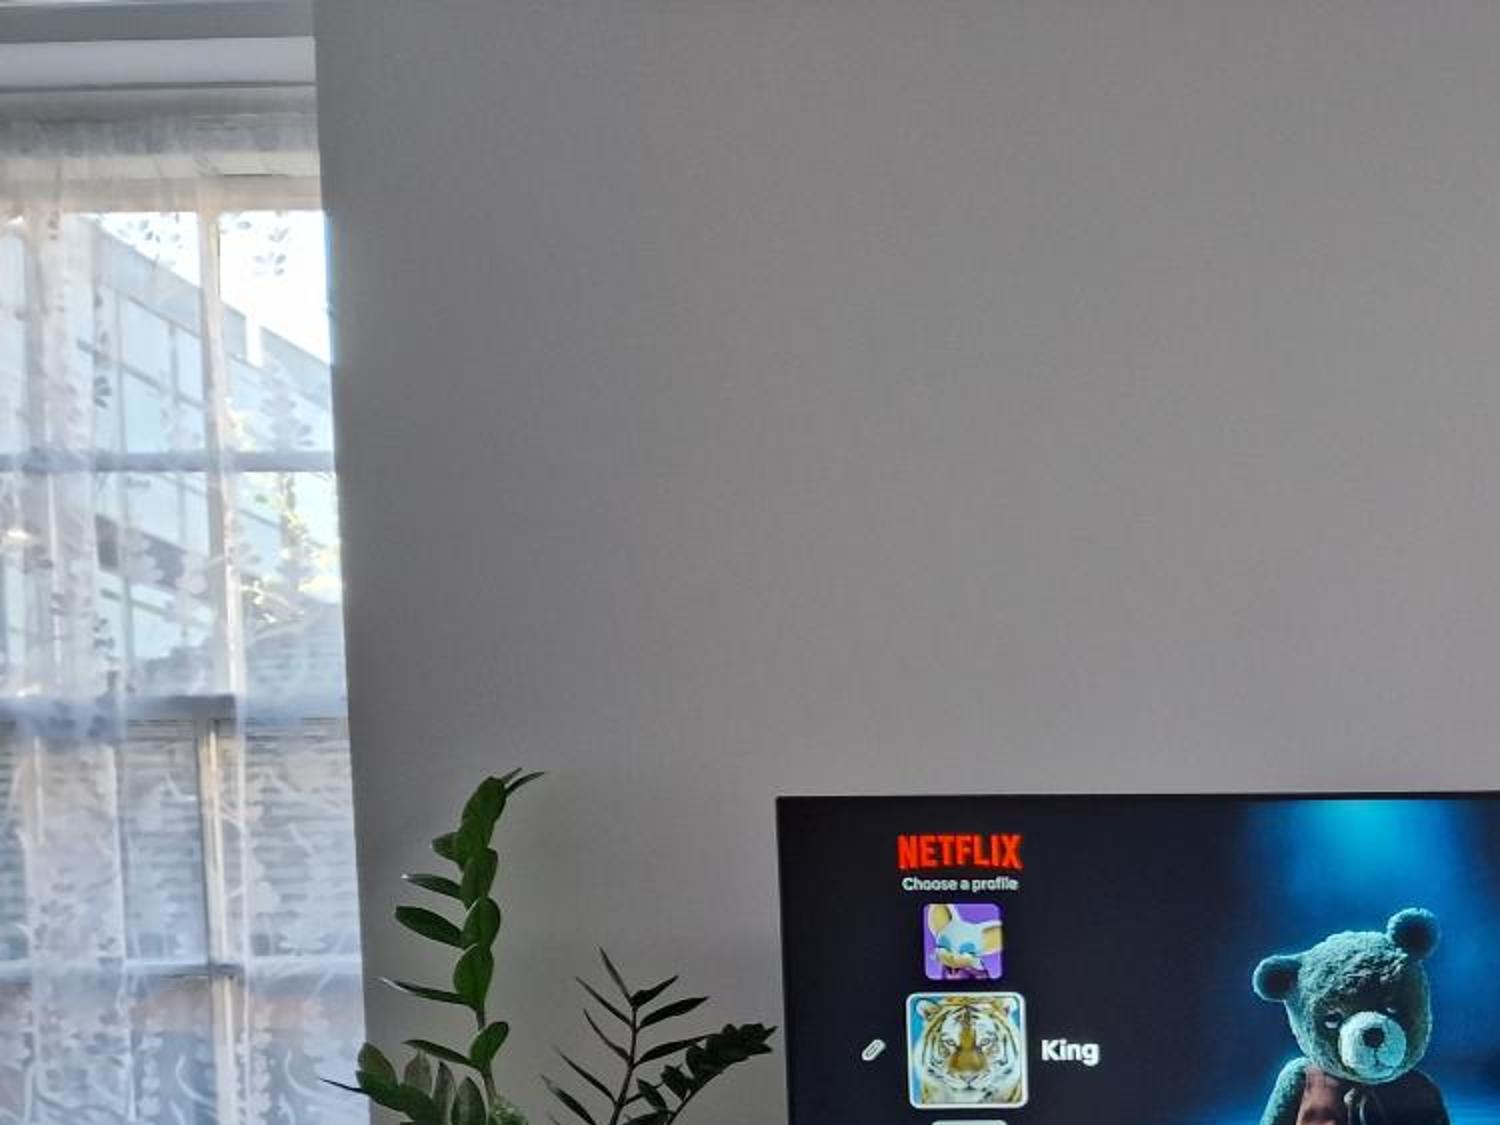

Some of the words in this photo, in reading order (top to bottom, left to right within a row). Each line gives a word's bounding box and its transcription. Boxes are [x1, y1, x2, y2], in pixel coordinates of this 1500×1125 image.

[897, 834, 1023, 869] NETFLIX
[901, 877, 959, 891] Choose
[960, 879, 971, 891] a
[971, 875, 1019, 893] profile
[1041, 1038, 1100, 1066] King
